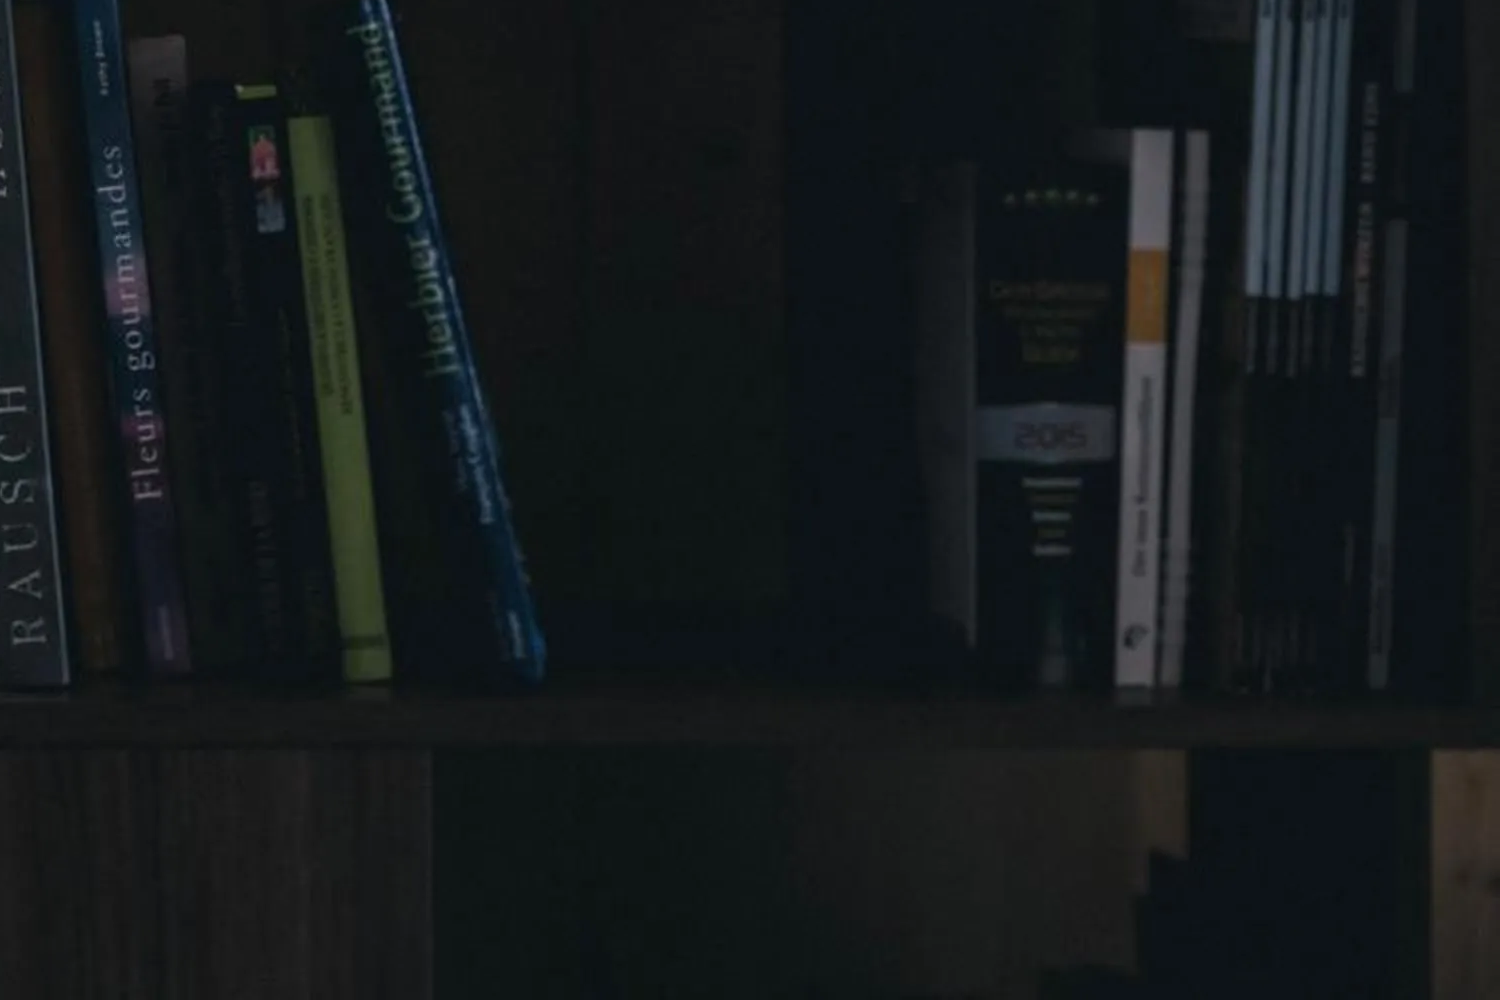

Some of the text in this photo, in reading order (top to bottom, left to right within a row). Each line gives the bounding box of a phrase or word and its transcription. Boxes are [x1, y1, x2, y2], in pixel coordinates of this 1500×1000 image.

[97, 144, 163, 501] Fleurs gourmandes
[345, 18, 462, 379] Herbier Gourmand
[1012, 420, 1089, 451] 2015
